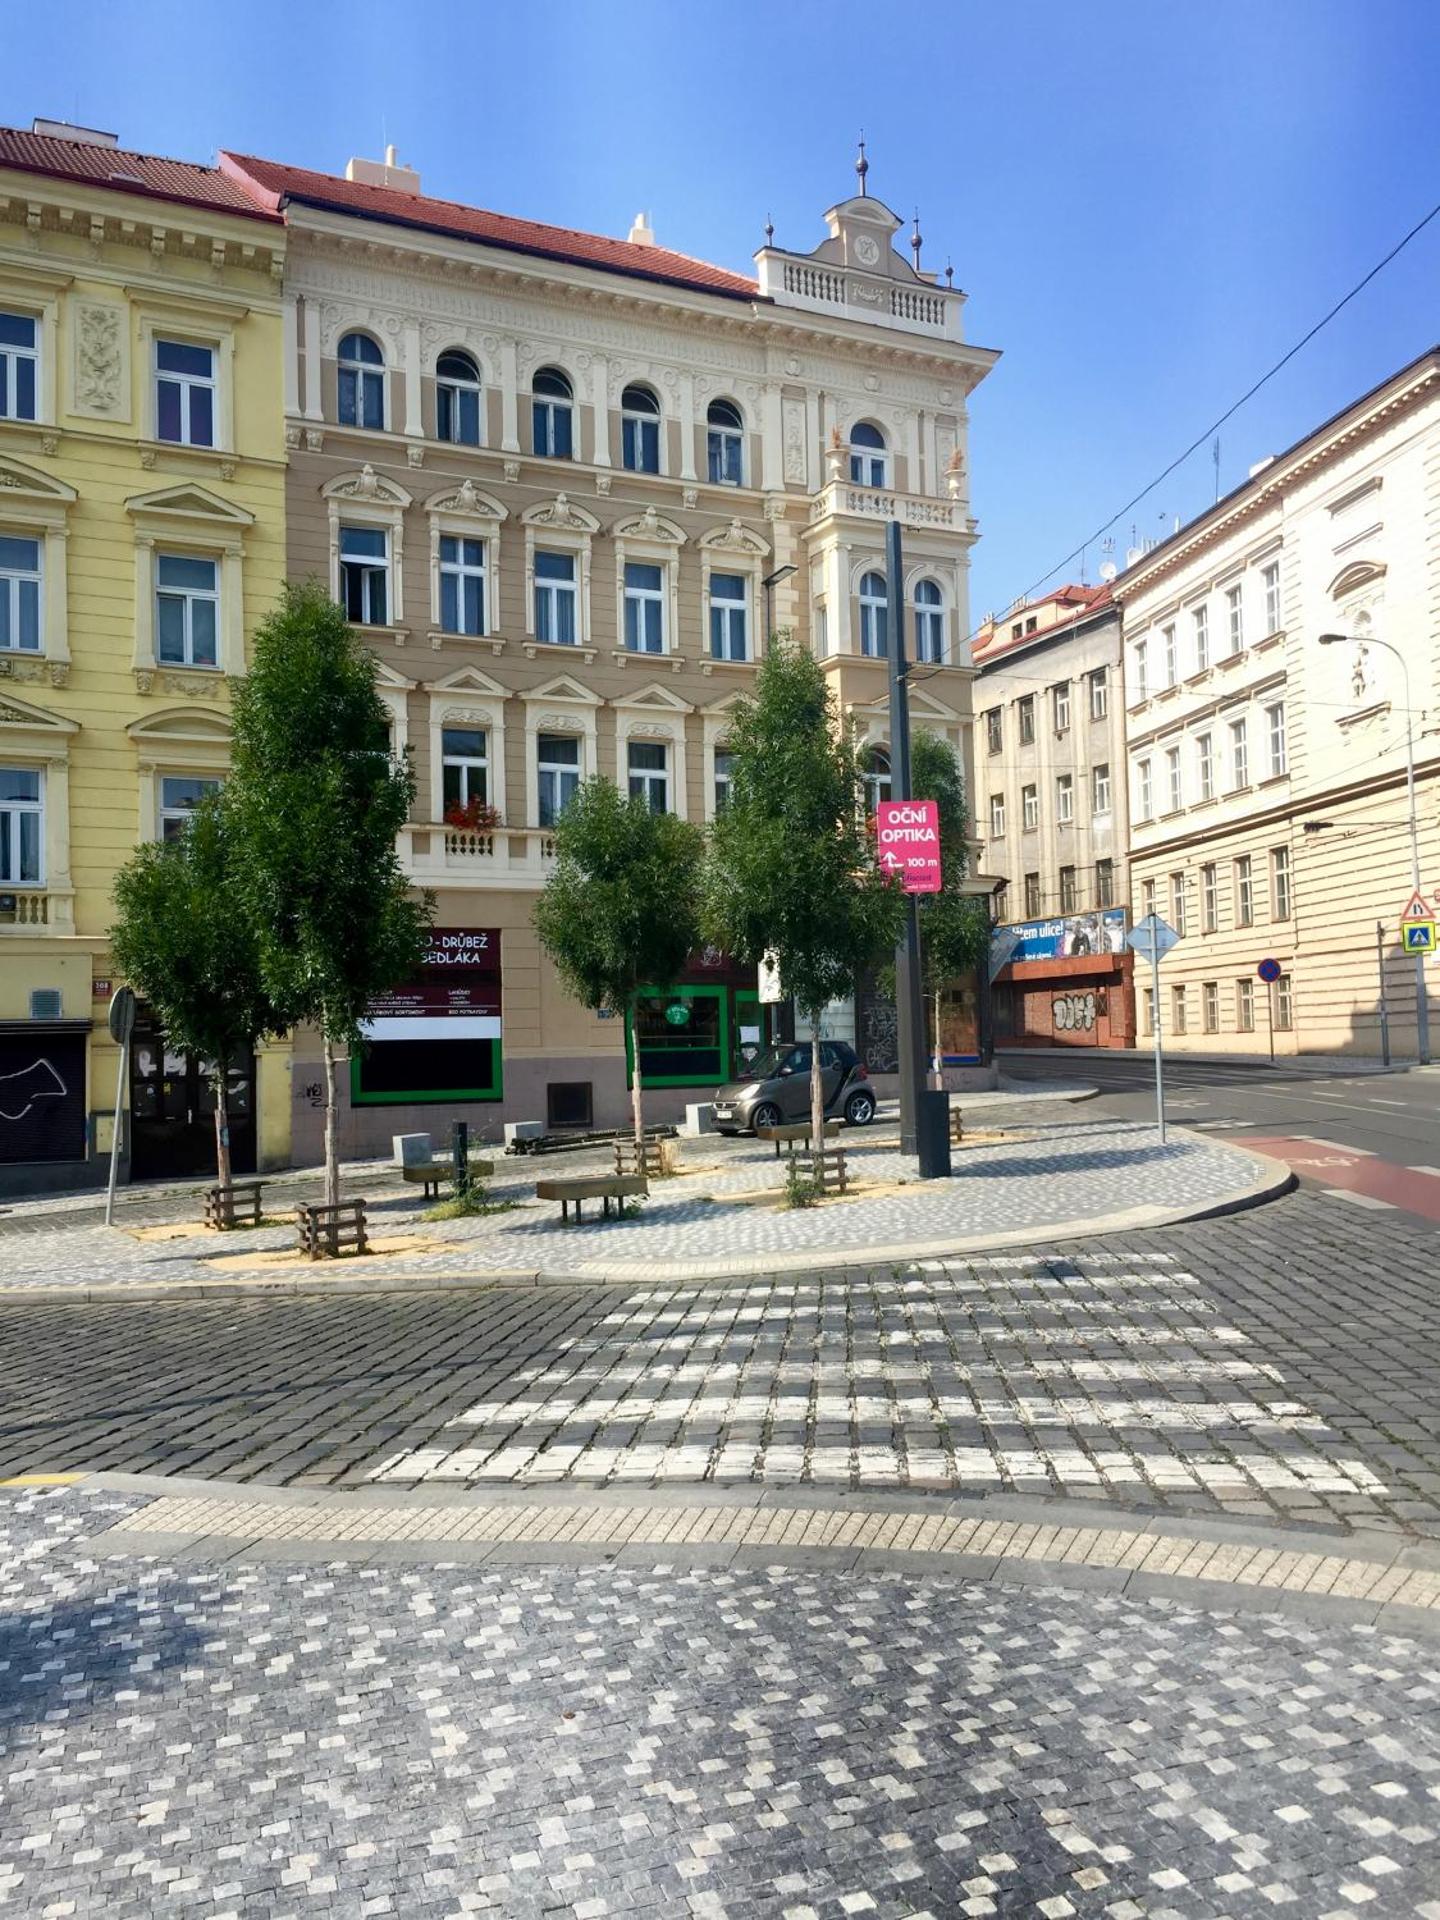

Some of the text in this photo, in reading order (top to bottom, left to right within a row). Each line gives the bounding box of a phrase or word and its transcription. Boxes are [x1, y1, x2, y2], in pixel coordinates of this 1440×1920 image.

[888, 807, 927, 824] OČNÍ
[881, 828, 936, 843] OPTIKA
[907, 857, 937, 867] 100 m
[1039, 919, 1064, 938] ulice!
[442, 932, 489, 948] DRŮBEŽ
[420, 949, 480, 963] SEDLÁKA
